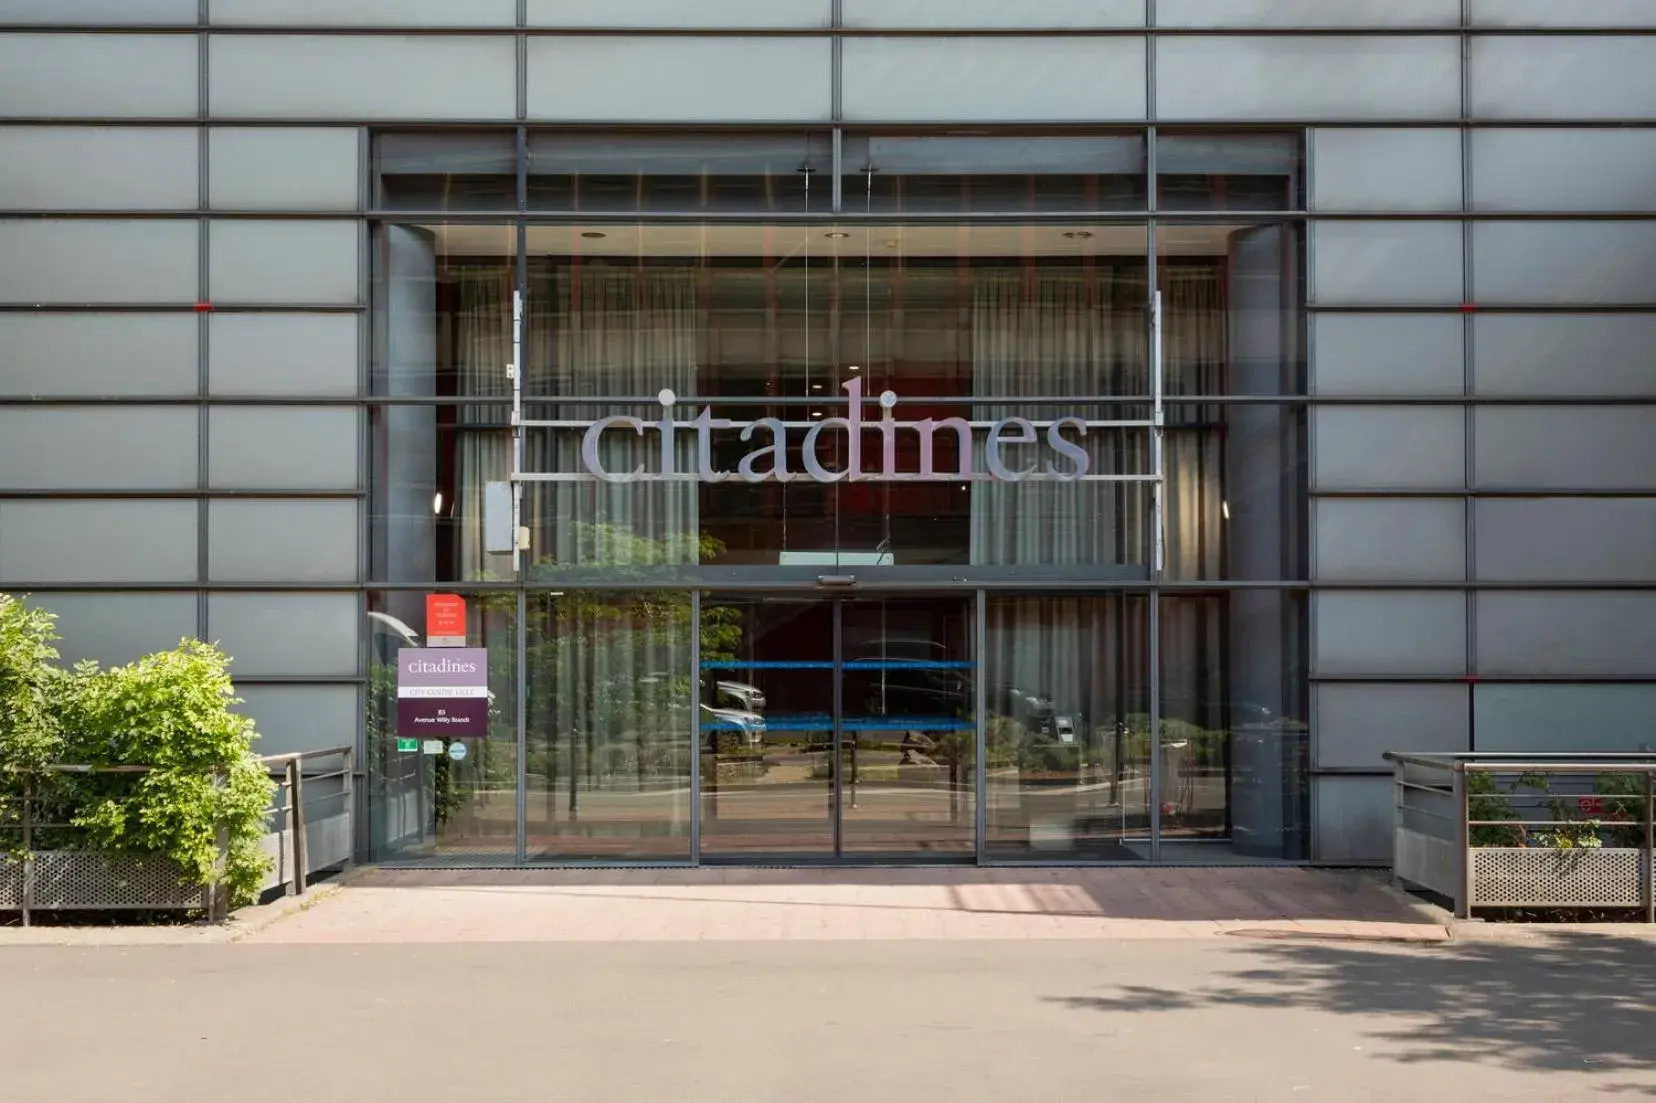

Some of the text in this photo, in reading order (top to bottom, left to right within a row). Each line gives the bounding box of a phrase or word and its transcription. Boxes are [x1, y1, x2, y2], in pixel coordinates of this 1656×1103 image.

[581, 376, 1091, 484] citadines
[408, 657, 477, 674] citadines
[437, 716, 451, 724] Willy
